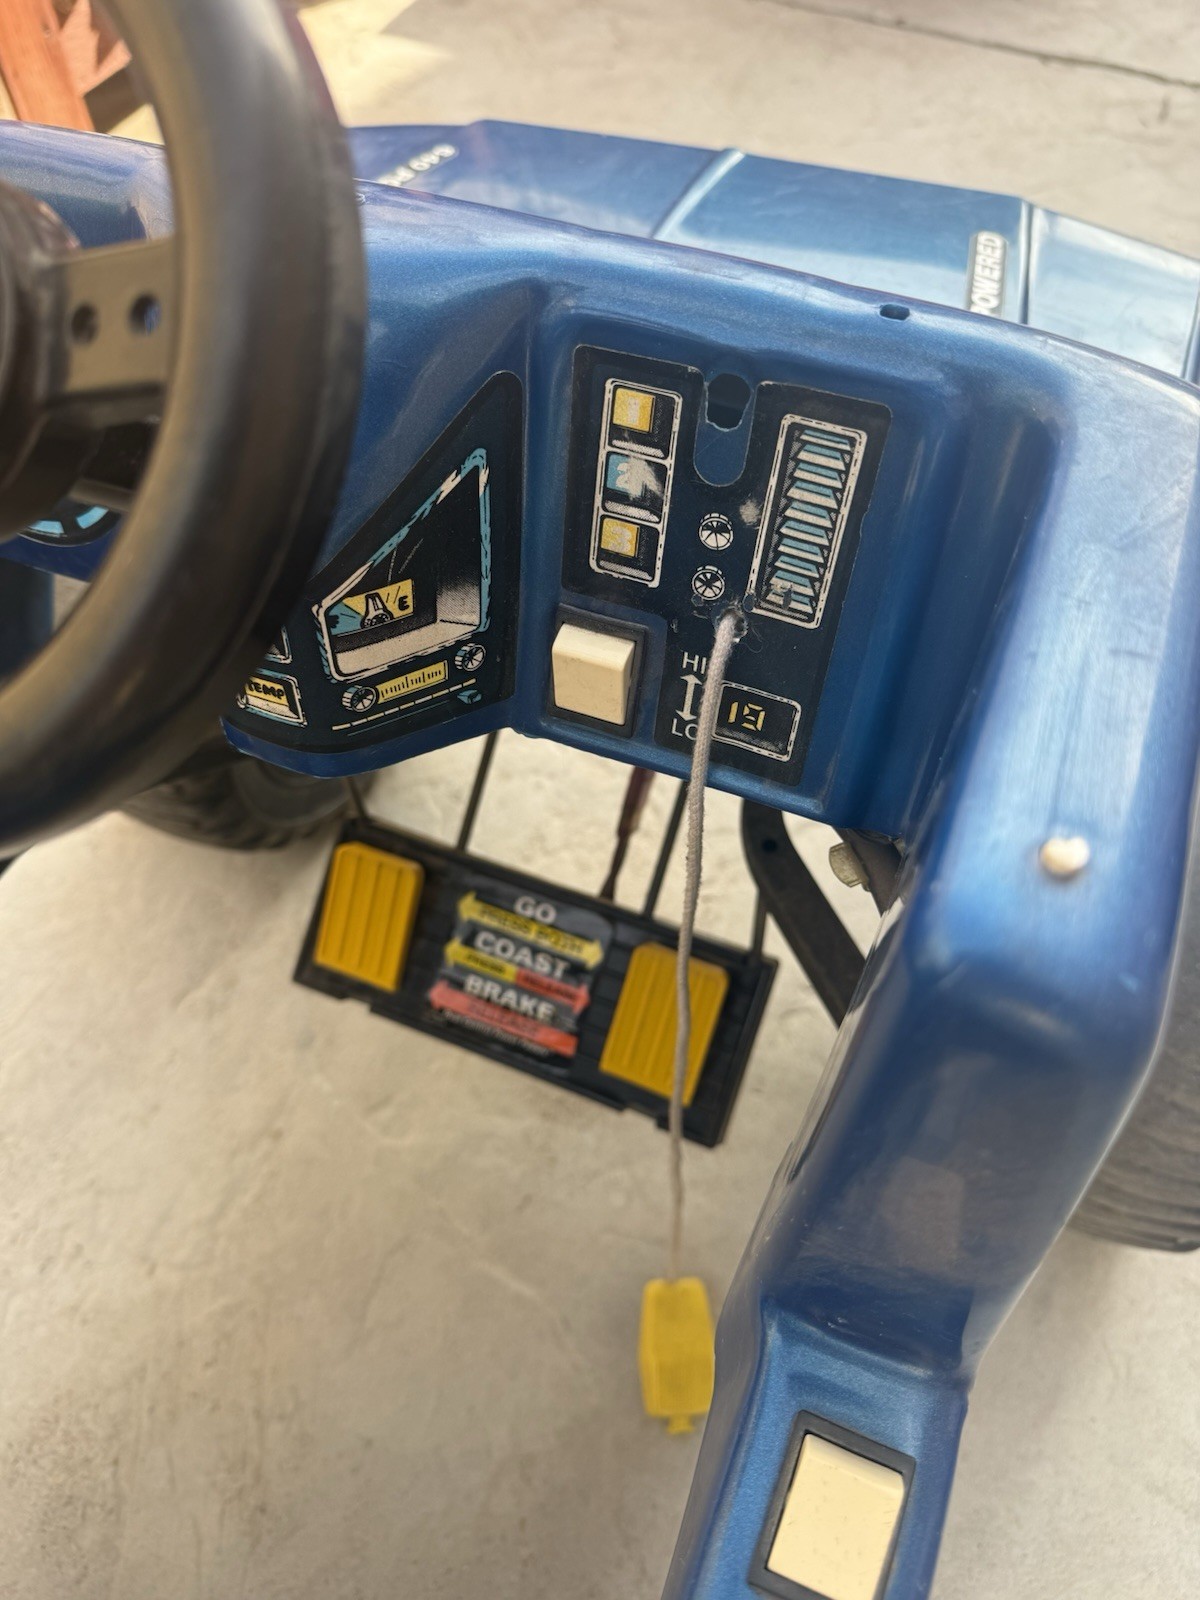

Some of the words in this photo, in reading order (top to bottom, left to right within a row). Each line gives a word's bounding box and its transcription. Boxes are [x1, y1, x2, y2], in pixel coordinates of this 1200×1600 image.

[607, 526, 632, 553] 3
[397, 595, 410, 612] E
[682, 651, 707, 675] HI
[727, 701, 766, 731] 19
[514, 896, 556, 922] GO
[474, 931, 569, 979] COAST
[465, 975, 555, 1020] BRAKE
